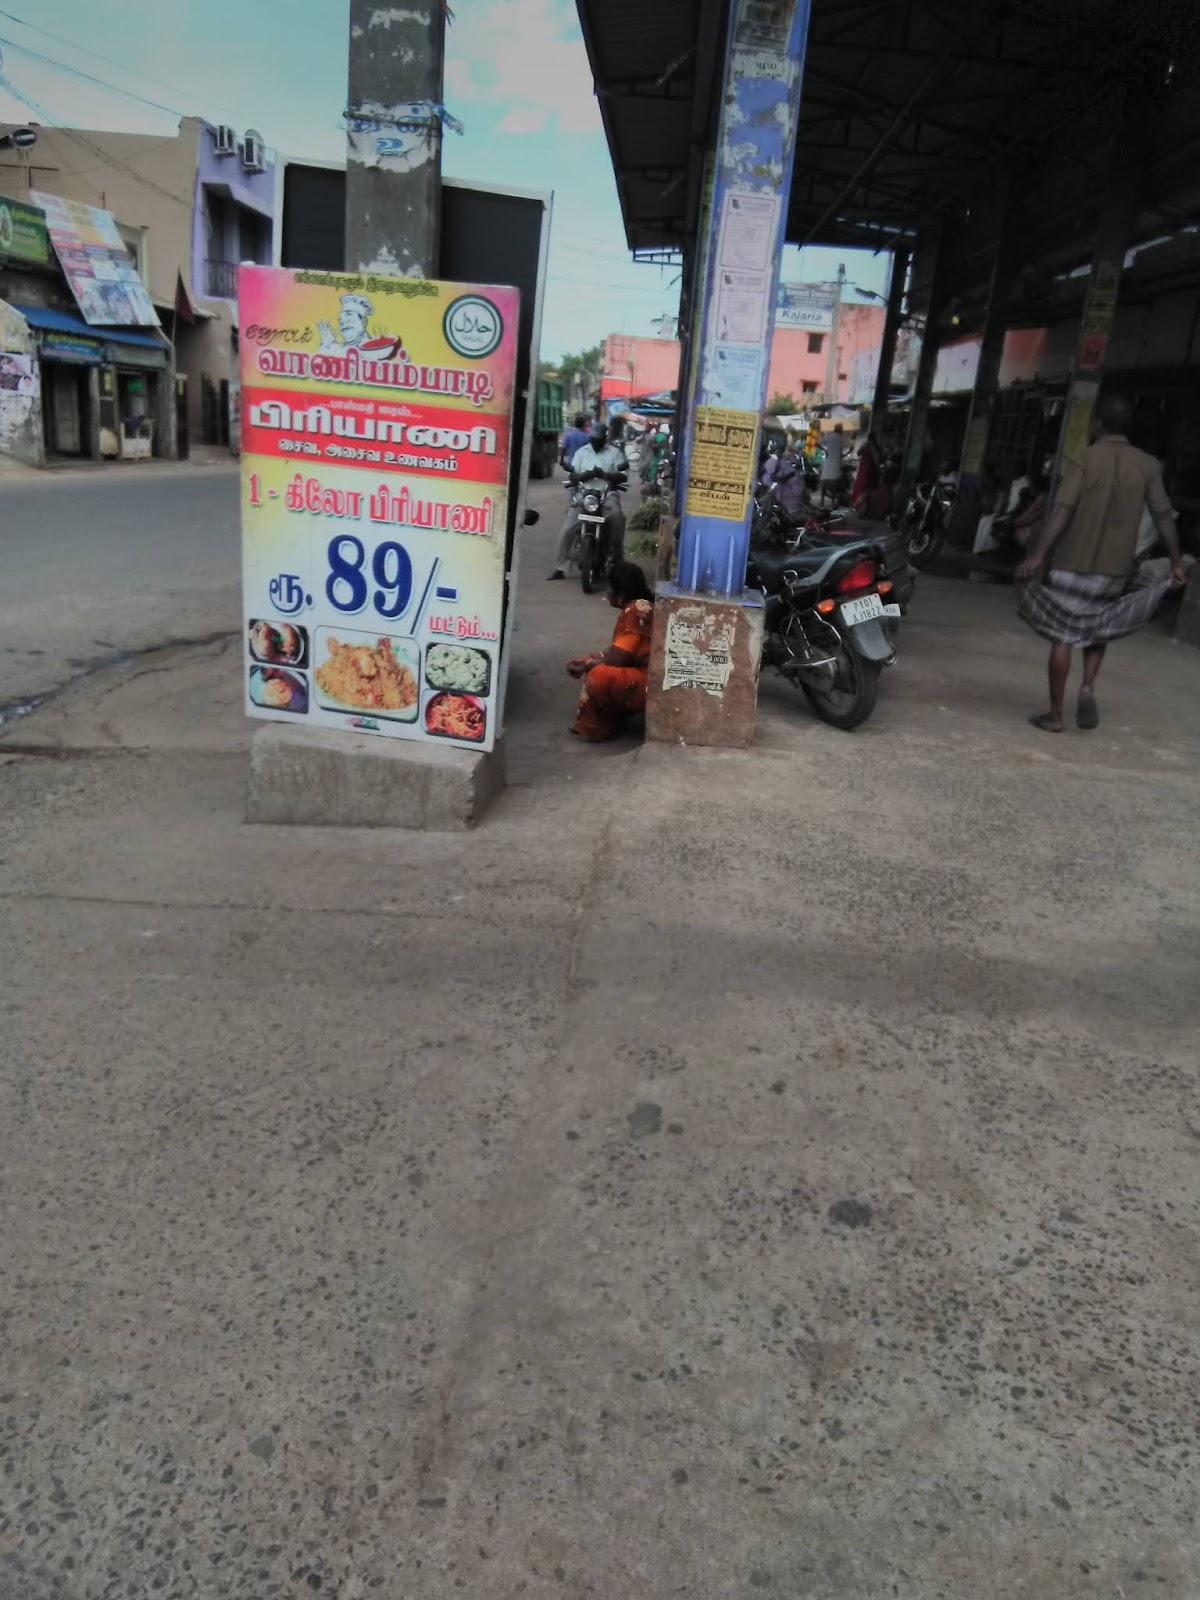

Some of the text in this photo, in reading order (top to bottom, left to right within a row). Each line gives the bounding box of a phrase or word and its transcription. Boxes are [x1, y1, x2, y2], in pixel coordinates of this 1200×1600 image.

[455, 311, 493, 334] حلال
[258, 347, 492, 406] வாணியம்பாடி
[250, 400, 497, 455] பிரியாணி
[325, 443, 381, 463] அசைவ
[384, 451, 458, 473] உணவகம்
[249, 473, 262, 506] 1
[286, 473, 362, 519] கிலோ
[368, 484, 494, 536] பிரியாணி
[325, 534, 458, 635] 89/-
